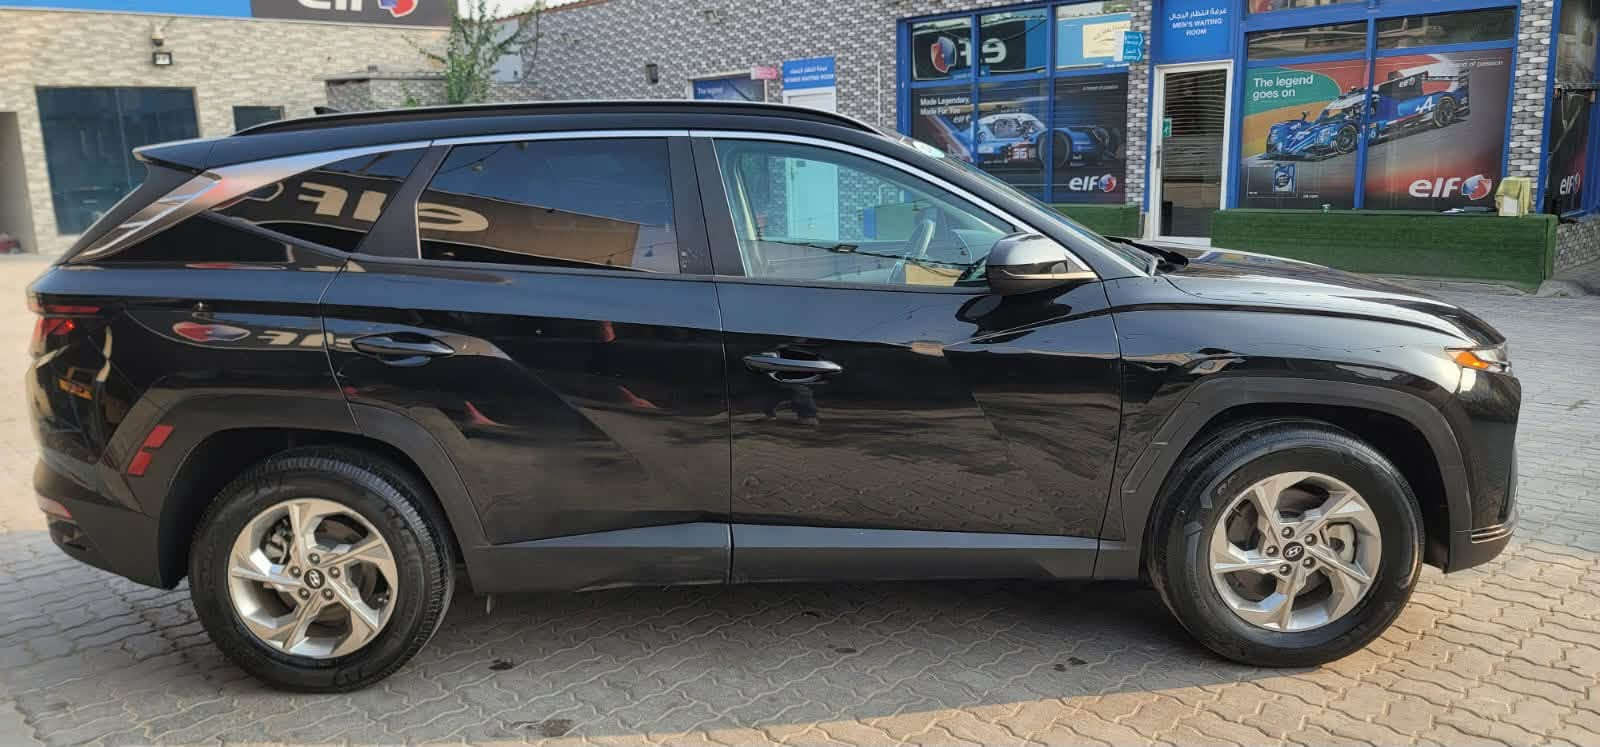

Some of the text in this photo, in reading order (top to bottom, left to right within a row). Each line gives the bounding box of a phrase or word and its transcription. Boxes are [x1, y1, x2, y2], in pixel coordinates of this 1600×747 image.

[1193, 18, 1223, 26] WAITING
[1185, 28, 1207, 36] ROOM
[1253, 74, 1314, 88] The legend
[1252, 89, 1296, 101] goes on
[938, 106, 948, 115] For
[1068, 176, 1099, 191] elf
[1409, 177, 1462, 198] elf
[1560, 175, 1575, 195] elf
